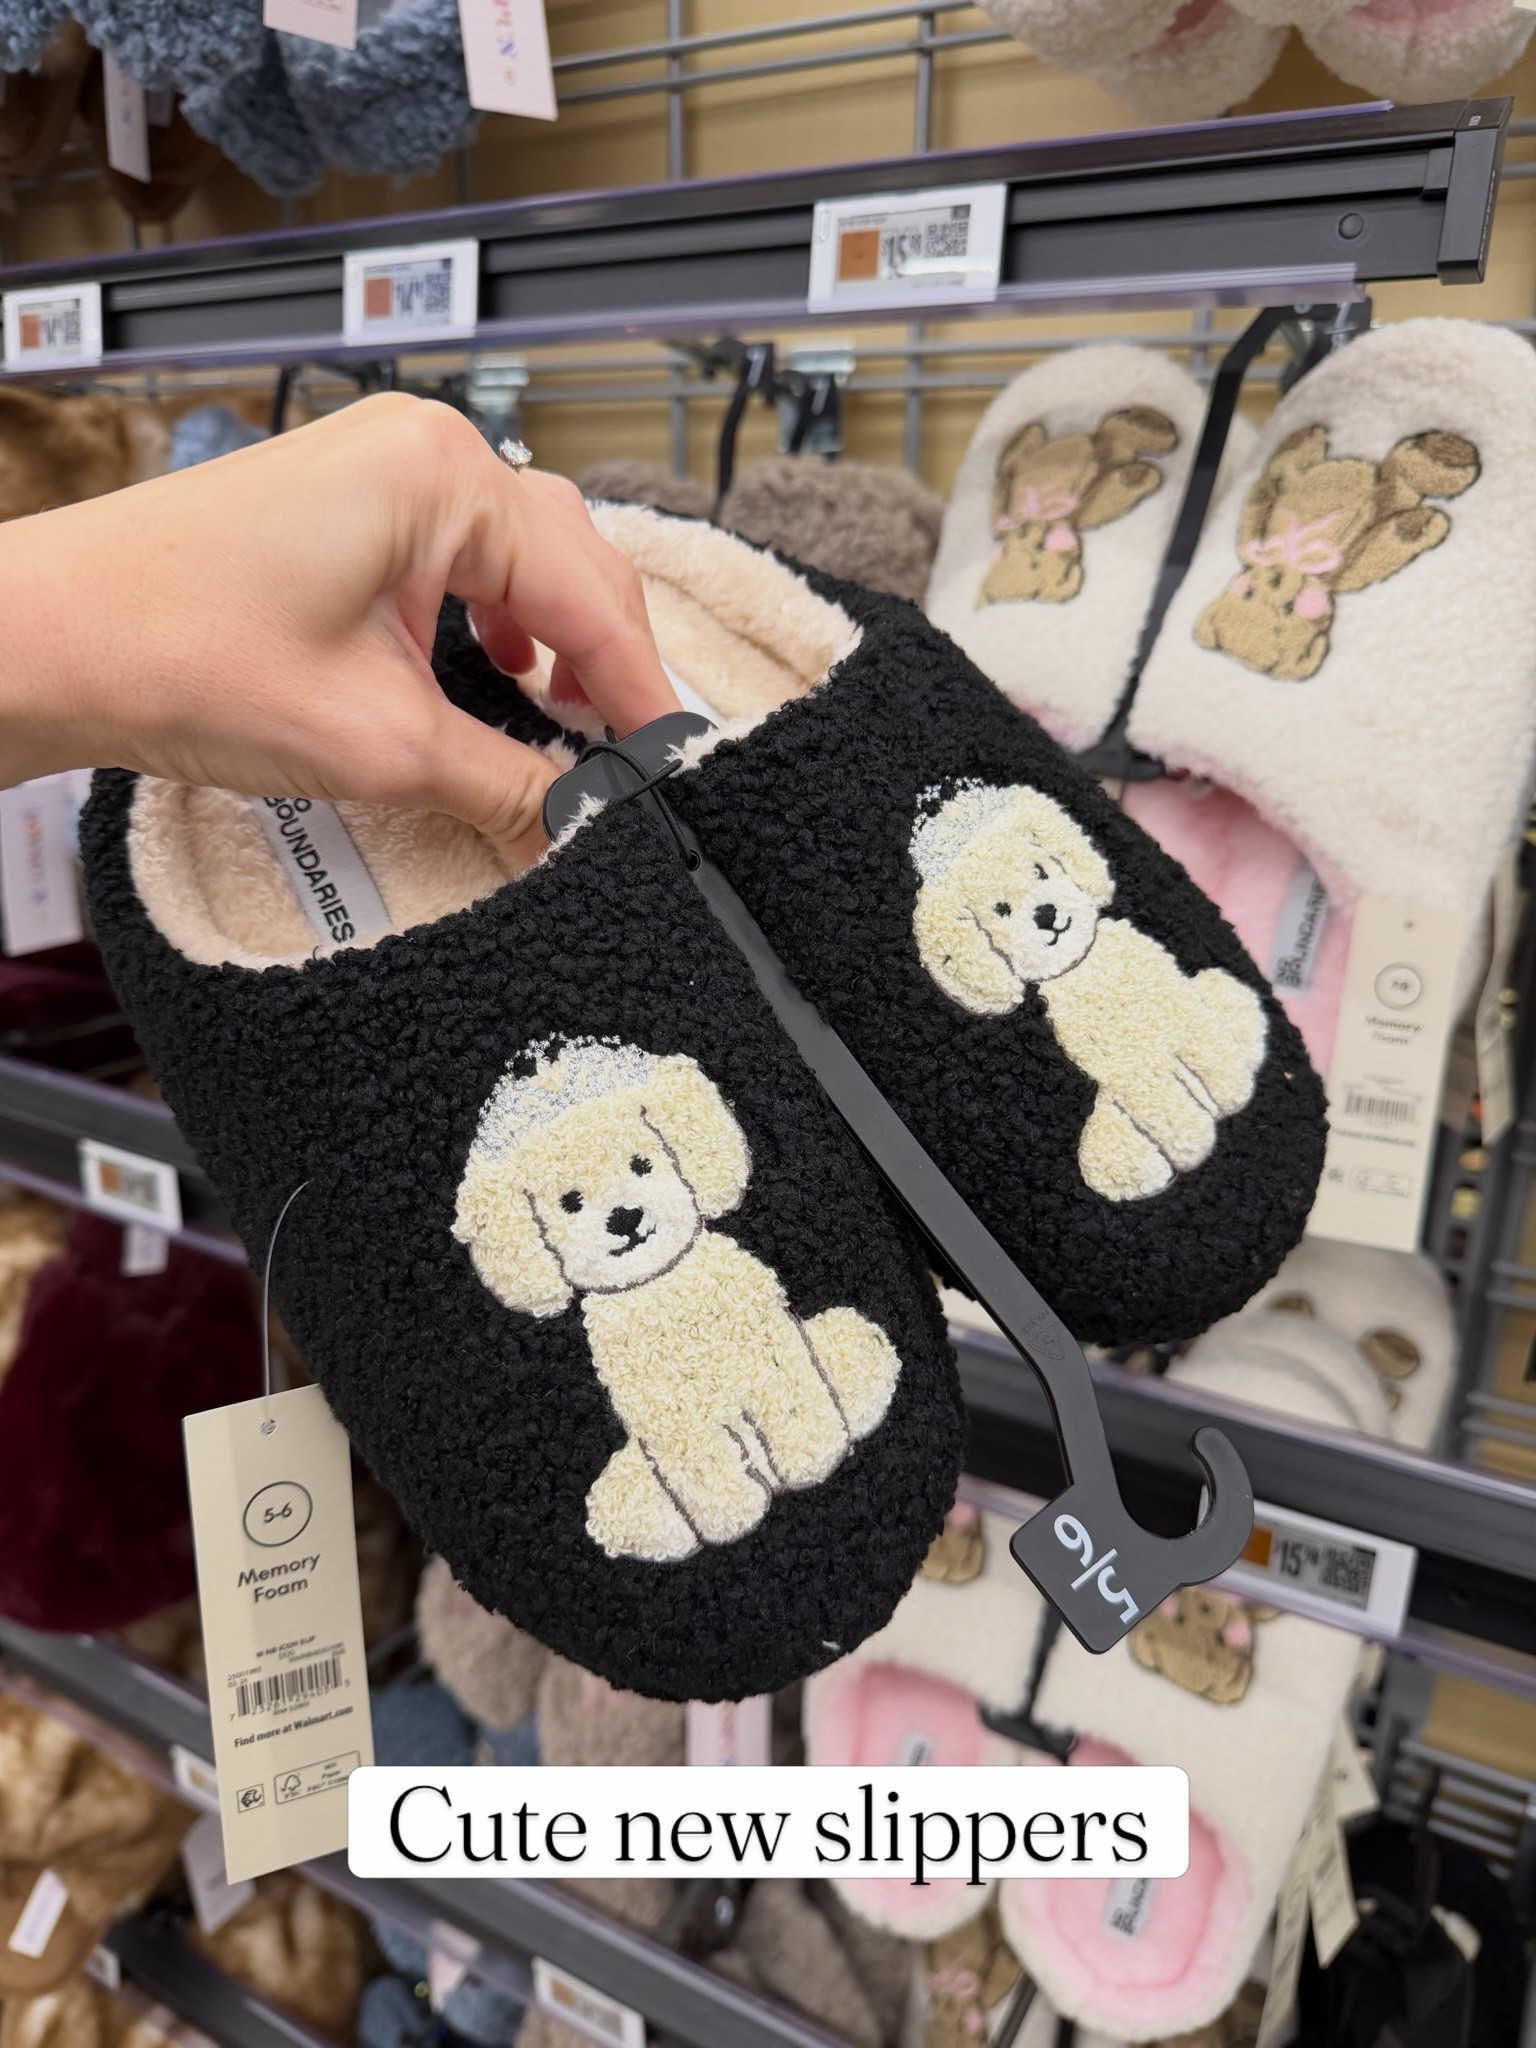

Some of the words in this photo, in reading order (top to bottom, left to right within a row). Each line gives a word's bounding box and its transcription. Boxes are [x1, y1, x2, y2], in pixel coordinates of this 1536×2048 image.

[264, 1502, 293, 1523] 5-6
[237, 1553, 321, 1588] Memory
[253, 1578, 309, 1603] Foam
[234, 1733, 255, 1748] Find
[257, 1727, 280, 1741] more
[282, 1723, 292, 1734] at
[294, 1705, 354, 1731] Walmart.com
